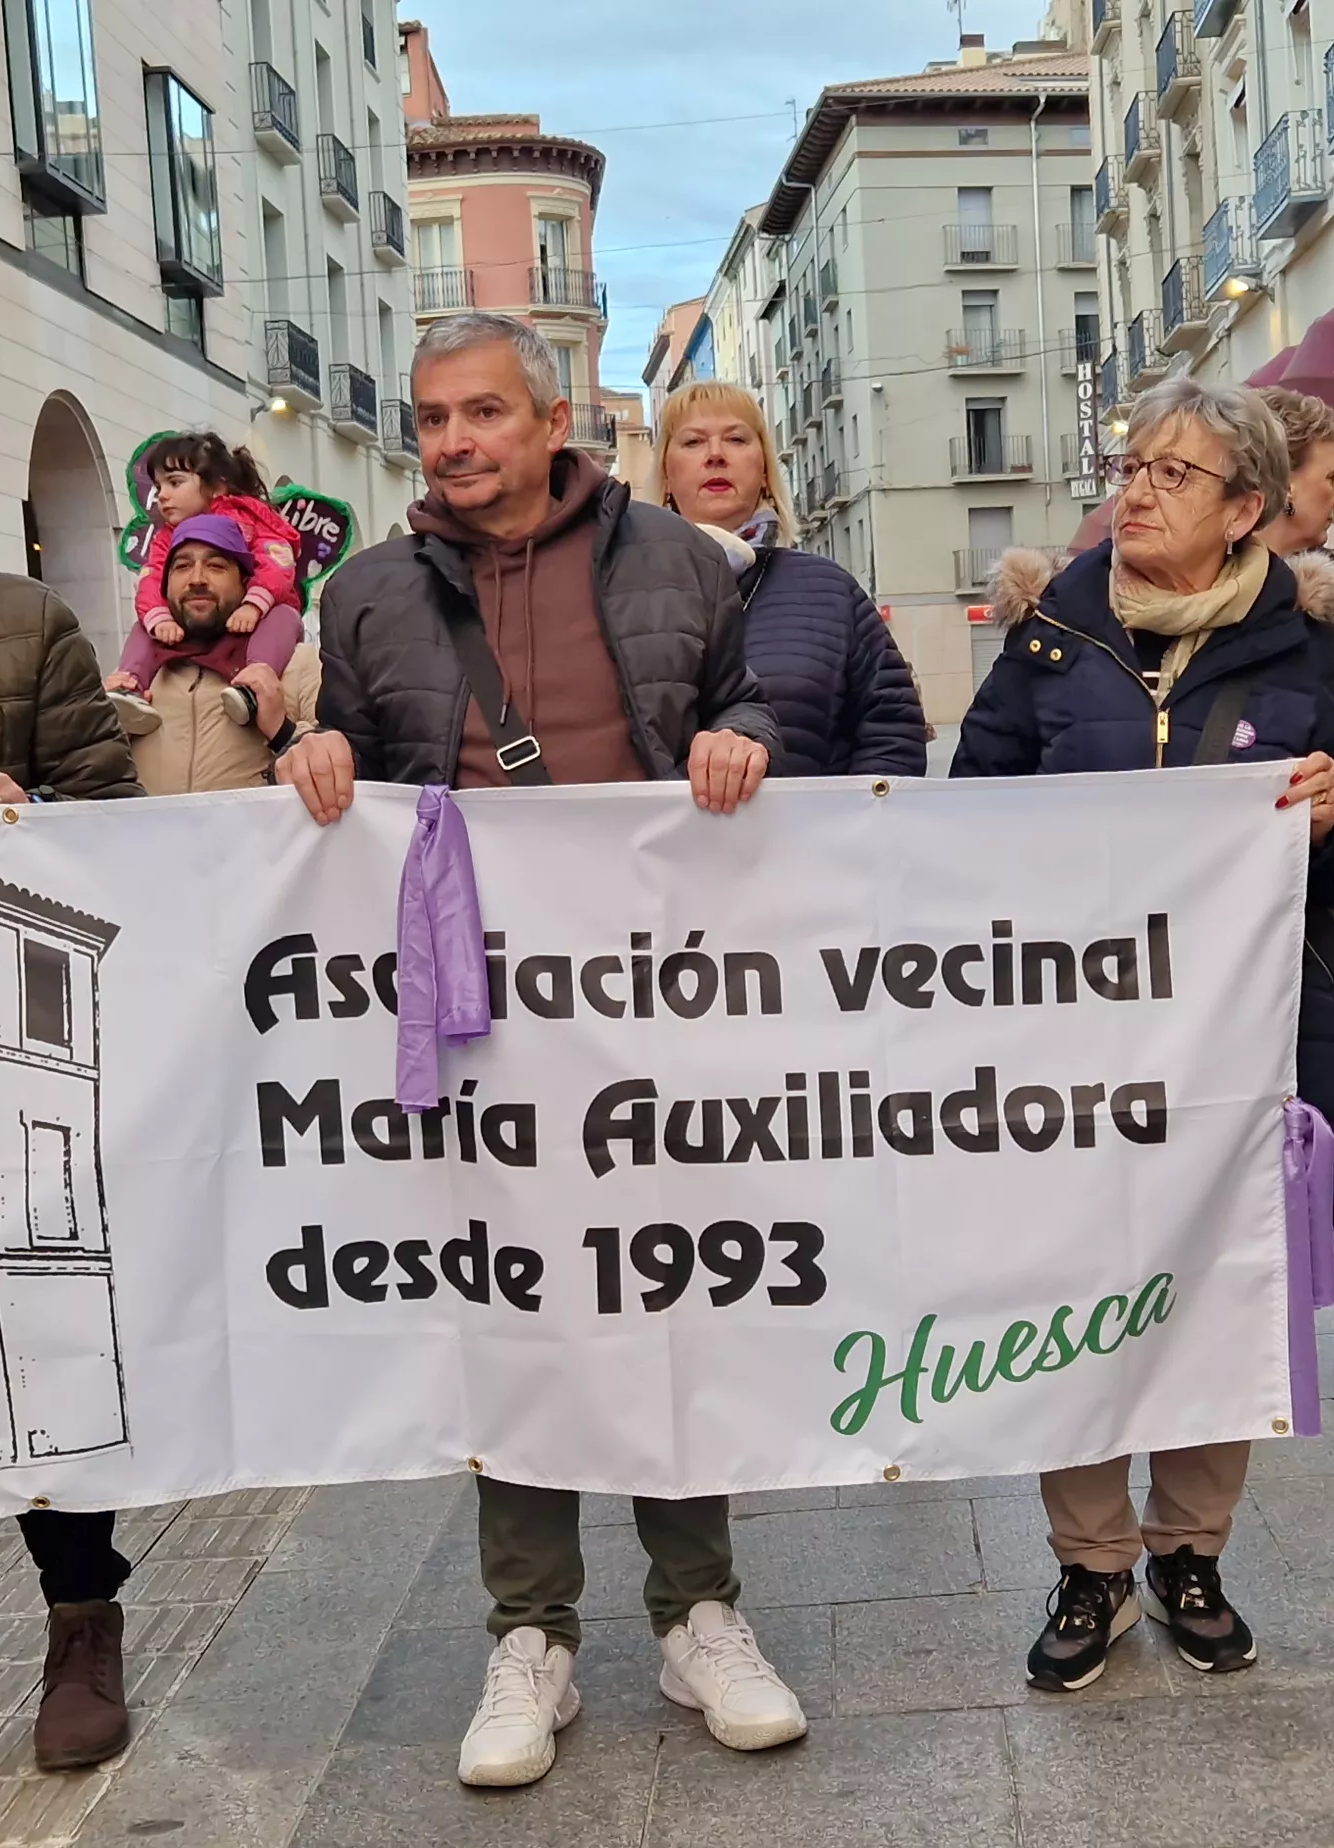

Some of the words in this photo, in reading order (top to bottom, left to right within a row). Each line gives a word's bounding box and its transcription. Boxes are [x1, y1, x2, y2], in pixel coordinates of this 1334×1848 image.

[1077, 362, 1095, 475] HOSTAL
[280, 499, 340, 543] Libre
[243, 930, 783, 1036] Asiación
[819, 912, 1173, 1013] vecinal
[256, 1078, 537, 1169] María
[582, 1066, 1168, 1179] Auxiliadora
[265, 1218, 544, 1313] desde
[582, 1220, 827, 1315] 1993
[830, 1270, 1176, 1435] Huesca
